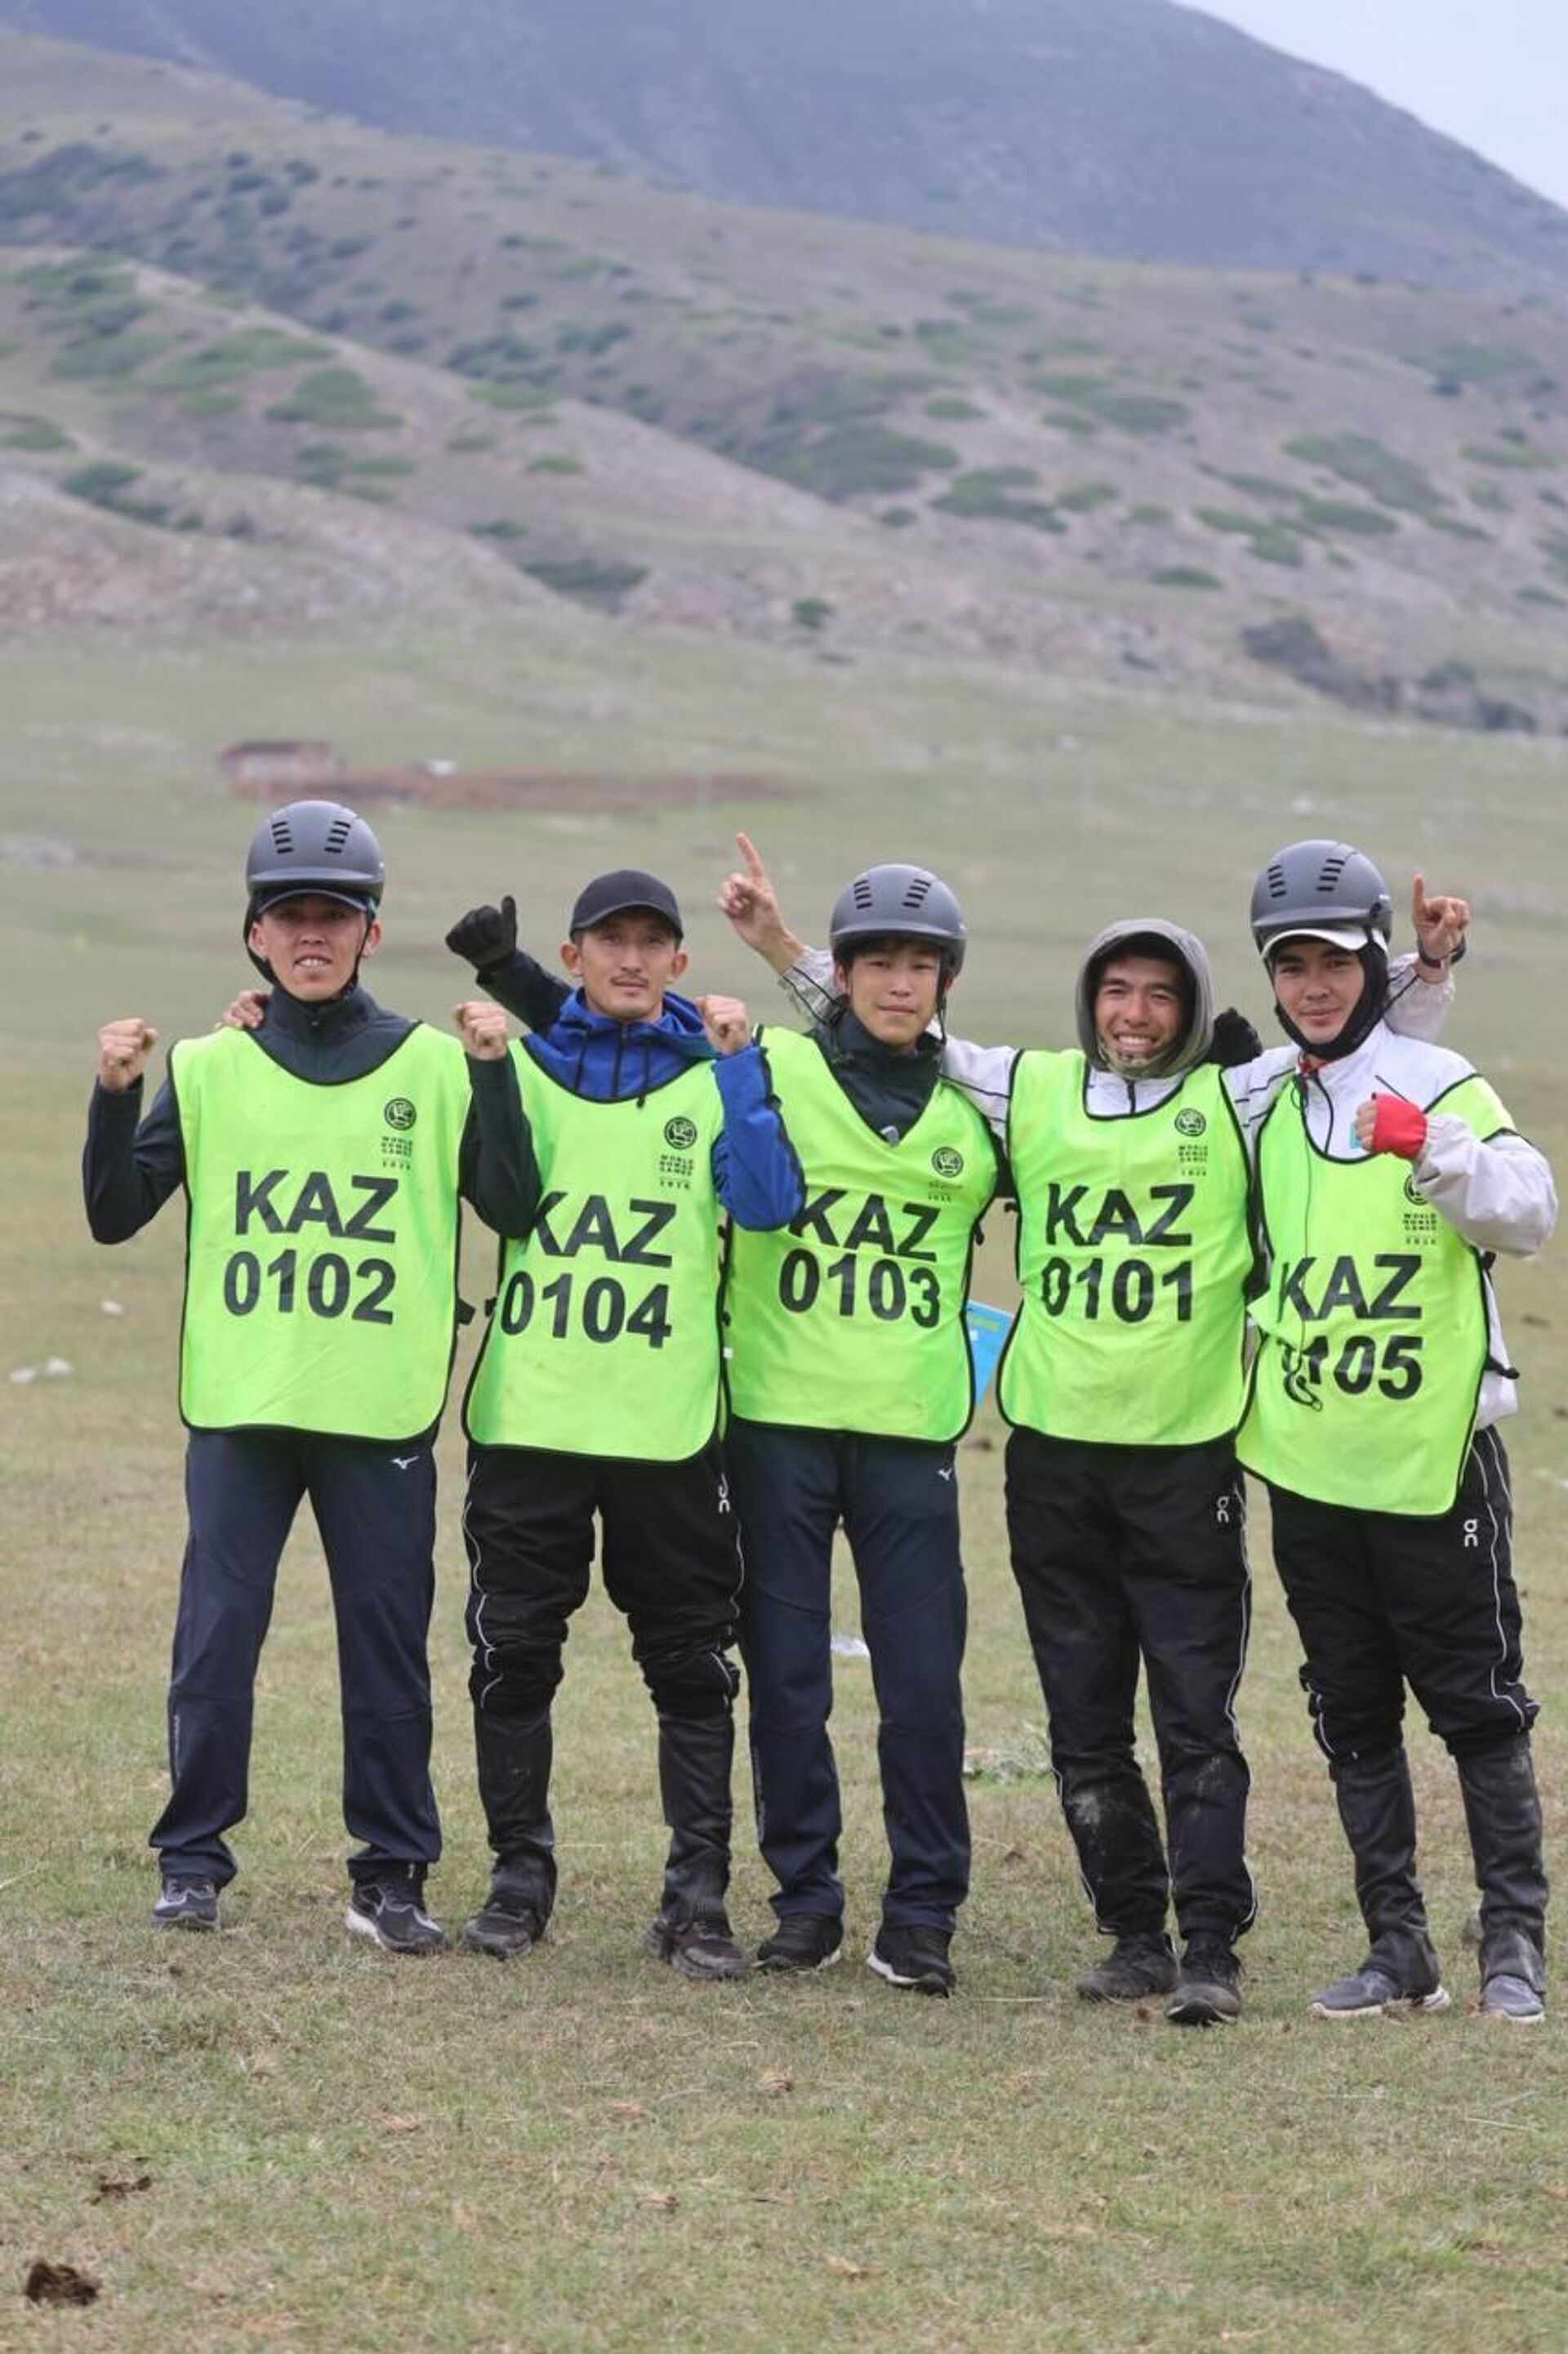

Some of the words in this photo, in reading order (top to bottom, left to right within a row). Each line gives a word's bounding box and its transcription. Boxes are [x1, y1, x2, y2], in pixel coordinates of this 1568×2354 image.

[235, 1170, 399, 1243] KAZ
[788, 1188, 942, 1263] KAZ
[1045, 1183, 1195, 1247] KAZ
[224, 1249, 396, 1325] 0102
[501, 1270, 673, 1348] 0104
[778, 1247, 941, 1328] 0103
[1041, 1256, 1192, 1323] 0101
[1277, 1254, 1422, 1323] KAZ
[1285, 1335, 1423, 1400] 105
